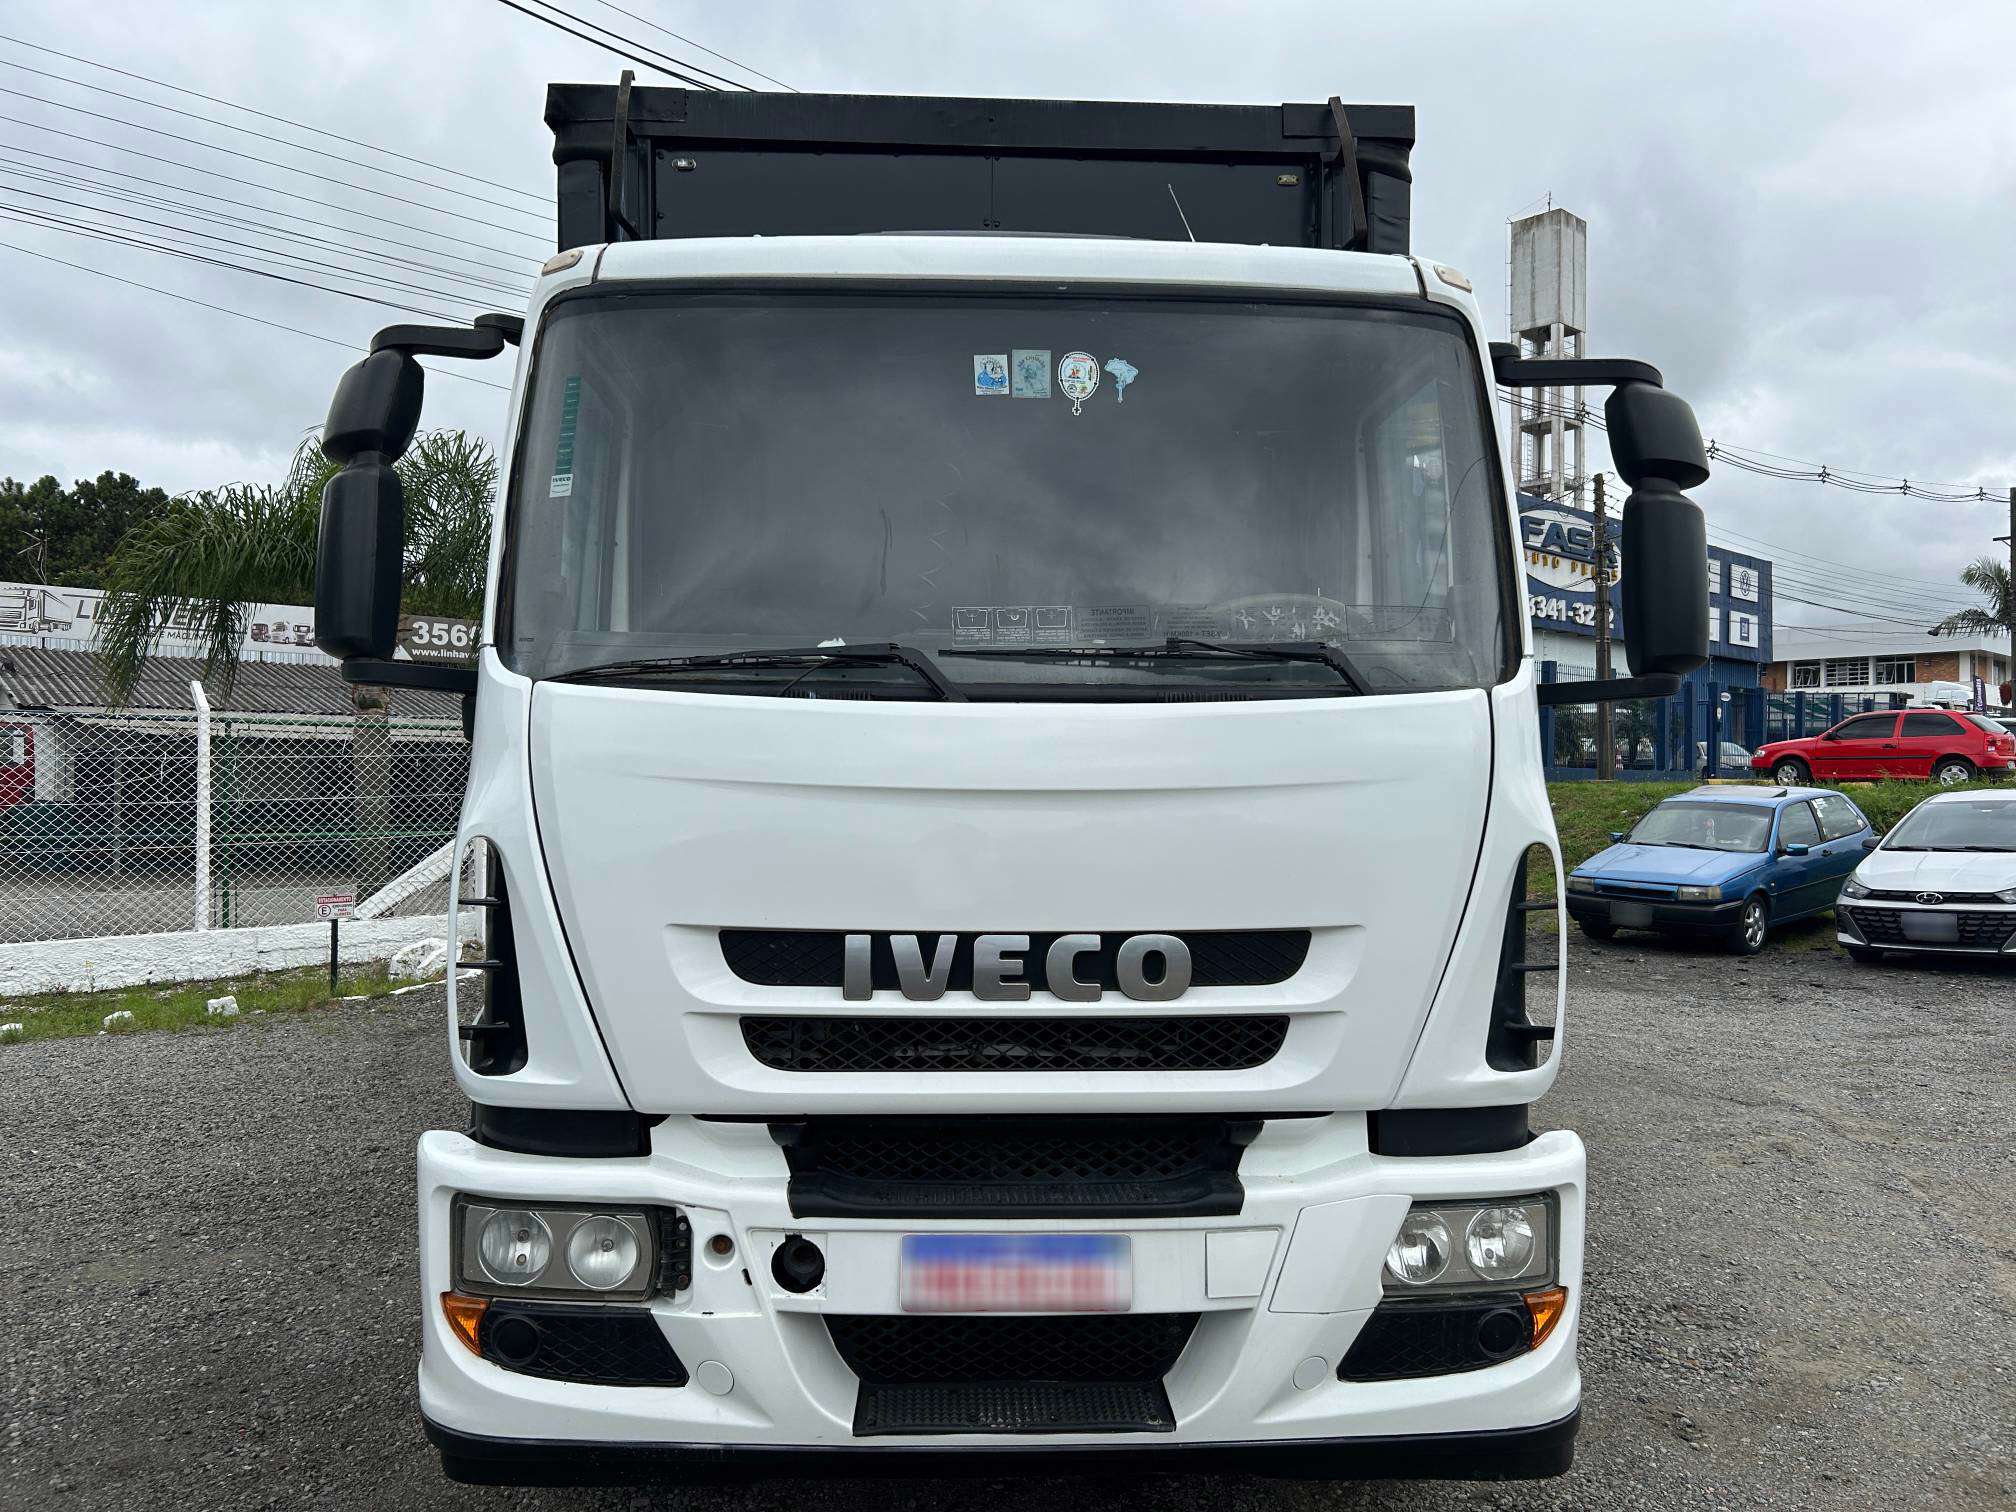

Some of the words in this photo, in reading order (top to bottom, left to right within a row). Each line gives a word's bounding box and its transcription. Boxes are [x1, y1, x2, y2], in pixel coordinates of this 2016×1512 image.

[1520, 516, 1617, 564] FAS
[411, 648, 477, 660] www.linhav
[321, 906, 328, 915] E
[843, 934, 1192, 1001] IVECO
